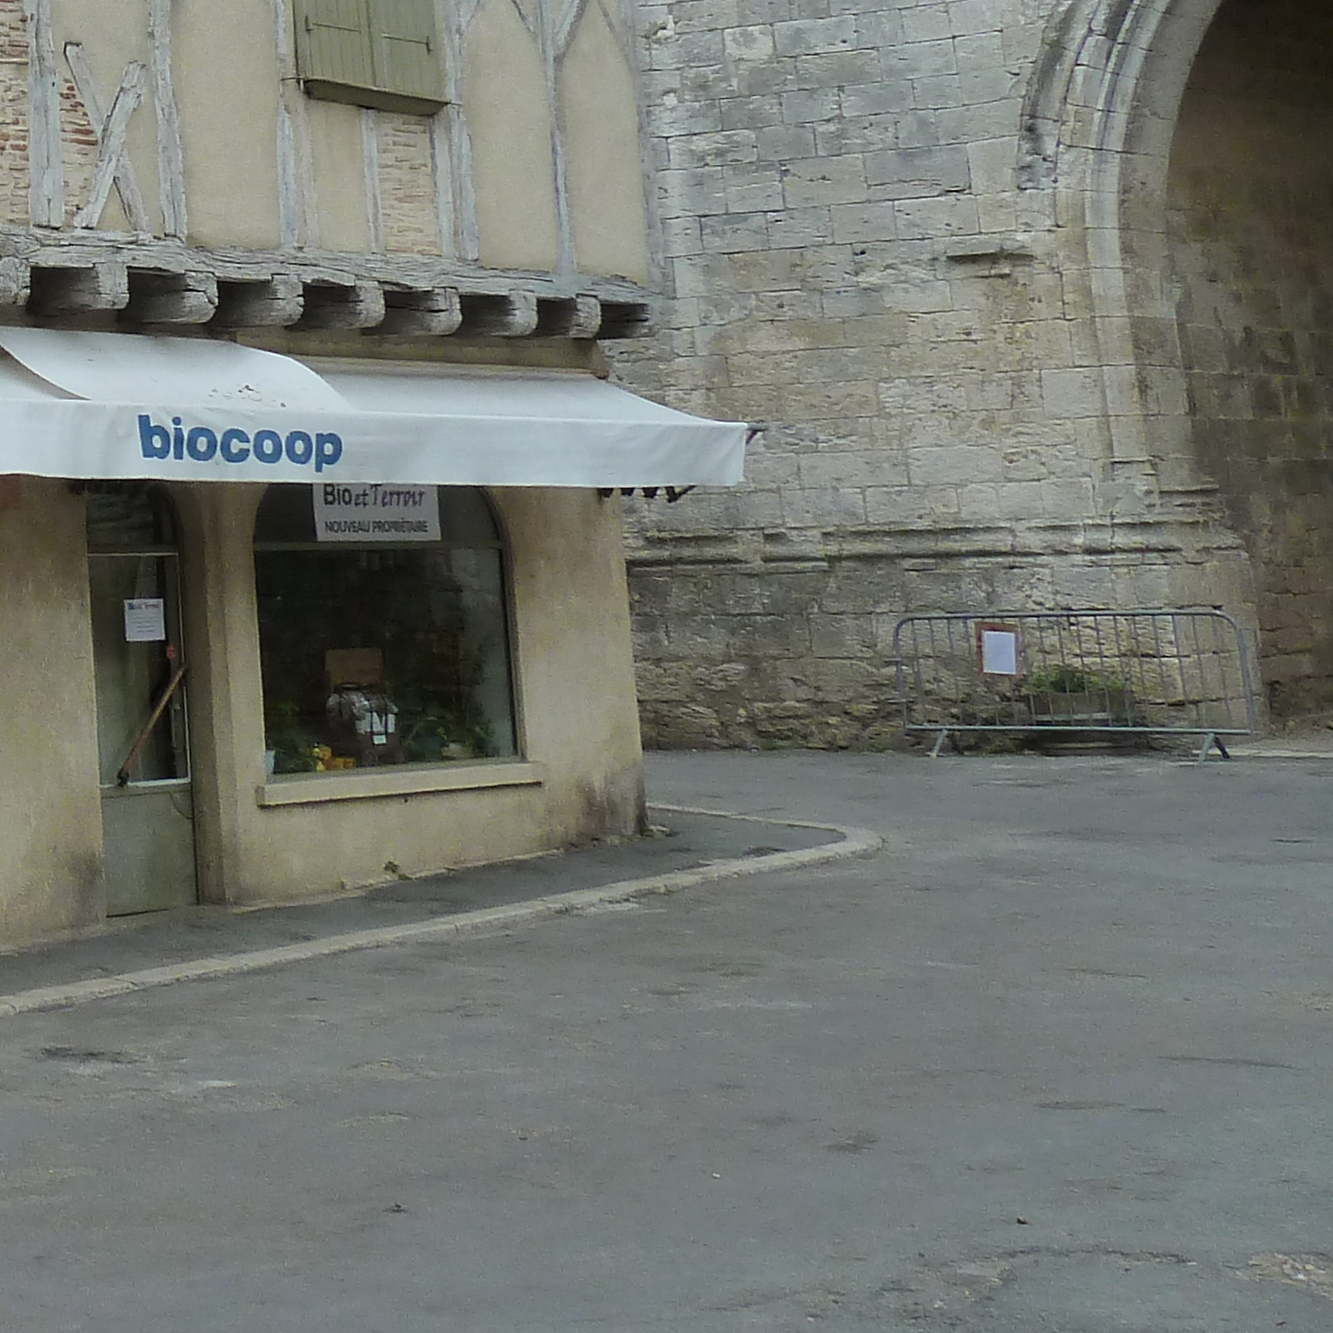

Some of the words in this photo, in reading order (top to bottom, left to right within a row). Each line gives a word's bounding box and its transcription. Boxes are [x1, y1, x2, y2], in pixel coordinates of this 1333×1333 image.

[138, 414, 343, 473] biocoop
[323, 483, 353, 506] Bio
[355, 489, 369, 507] et
[325, 520, 371, 534] NOUVEAU
